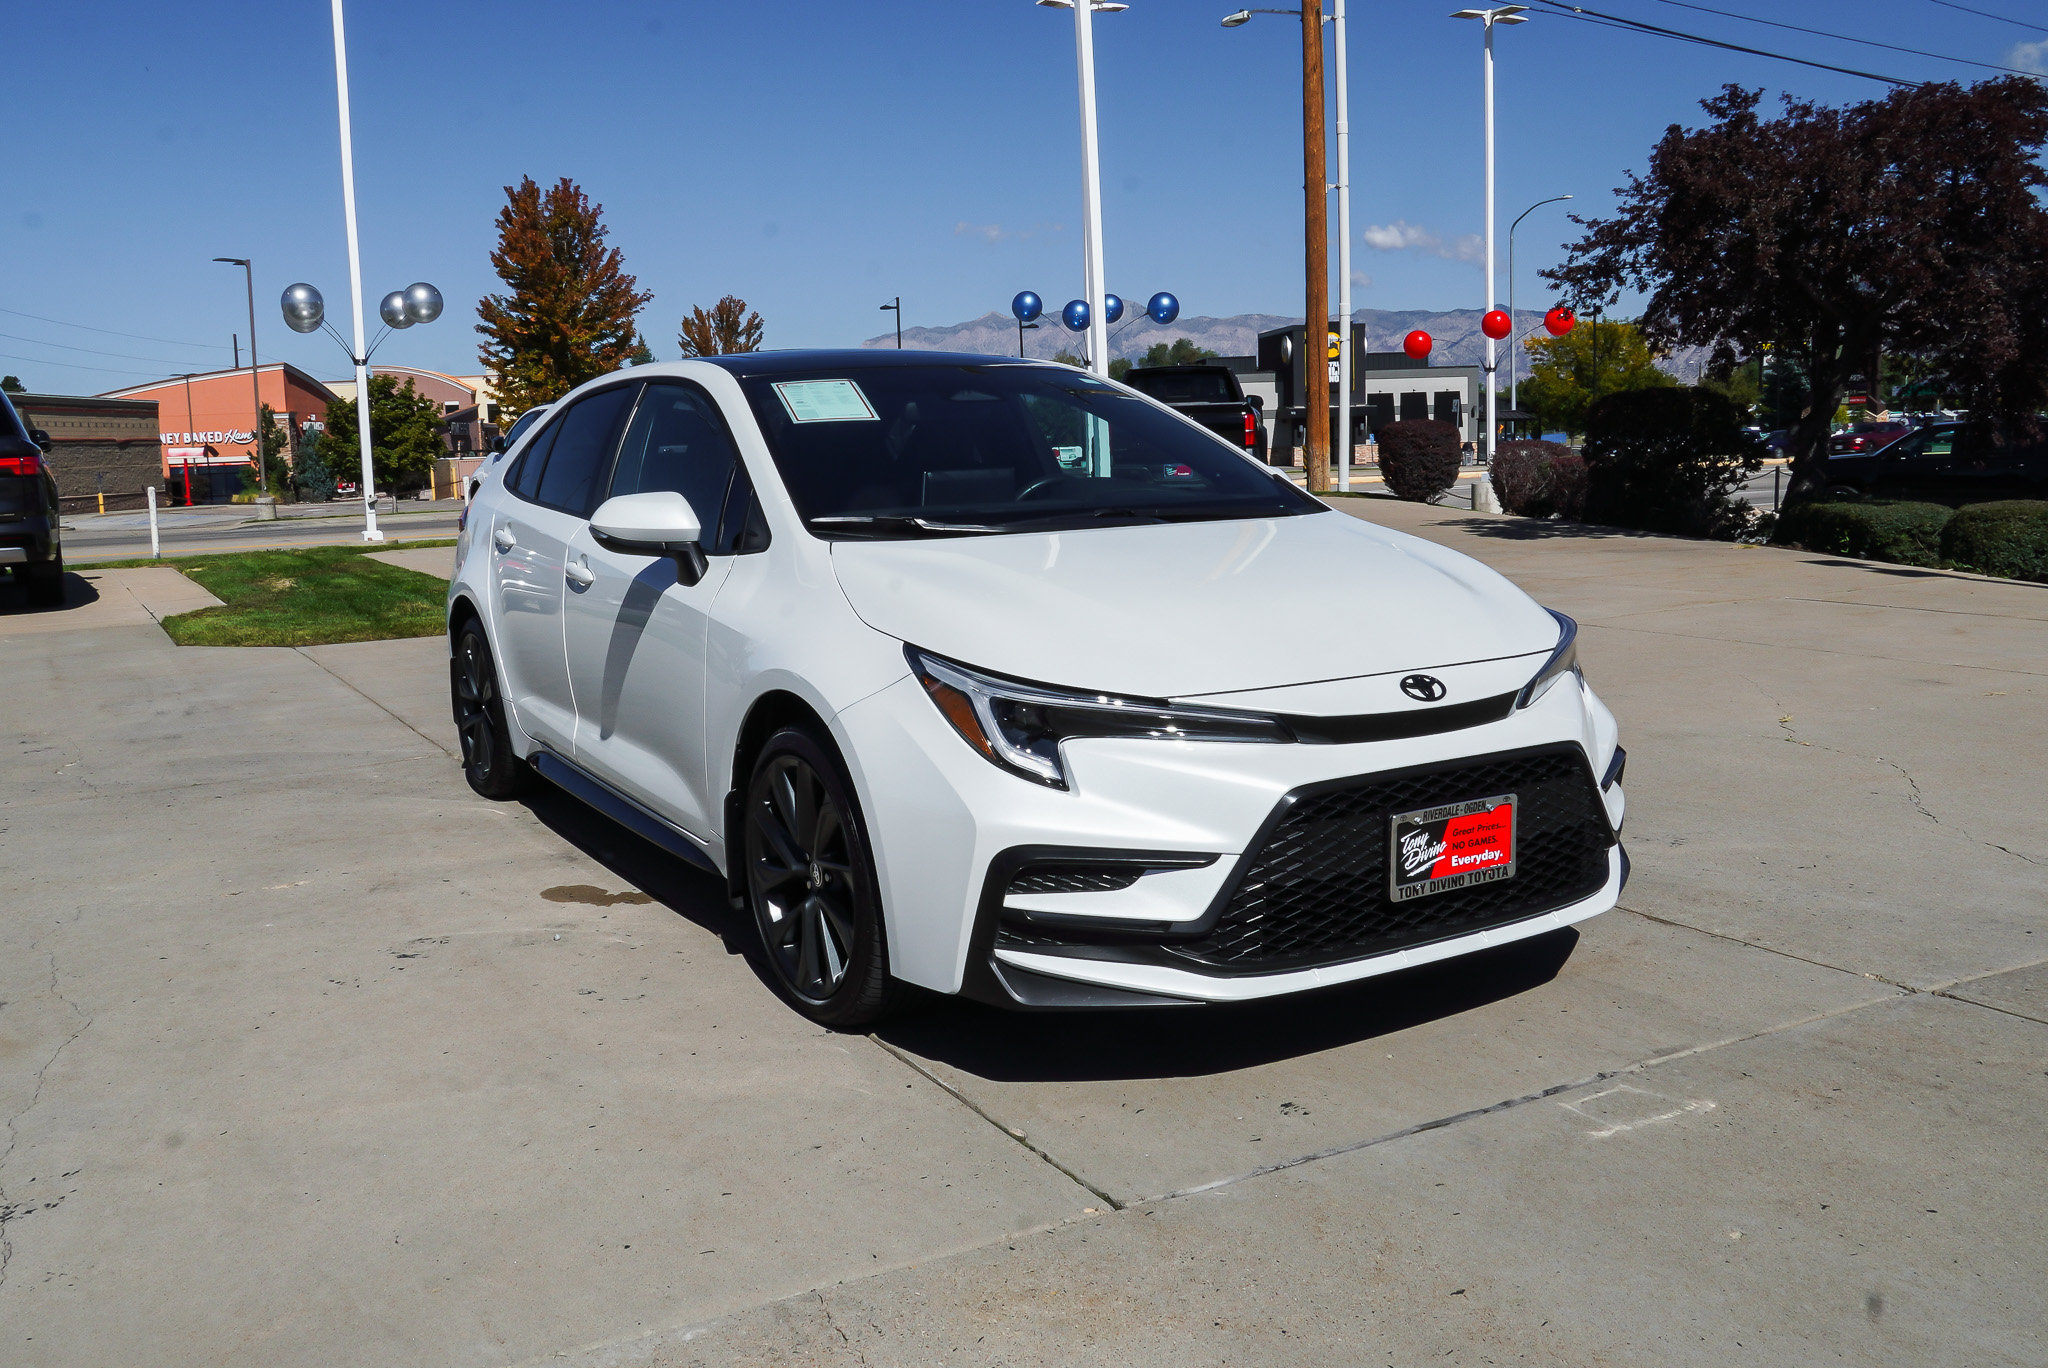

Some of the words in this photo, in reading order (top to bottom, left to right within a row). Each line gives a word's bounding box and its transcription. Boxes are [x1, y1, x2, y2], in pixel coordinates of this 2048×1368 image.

[160, 432, 180, 444] NEY
[183, 431, 223, 444] BAKED
[224, 429, 254, 445] Ham
[1452, 827, 1475, 837] Great
[1400, 829, 1430, 854] Tony
[1452, 840, 1465, 850] NO
[1400, 841, 1448, 870] Divino
[1451, 849, 1504, 867] Everyday.
[1398, 882, 1427, 900] TONY
[1429, 874, 1465, 893] DIVINO
[1467, 866, 1509, 884] TOYOTA
